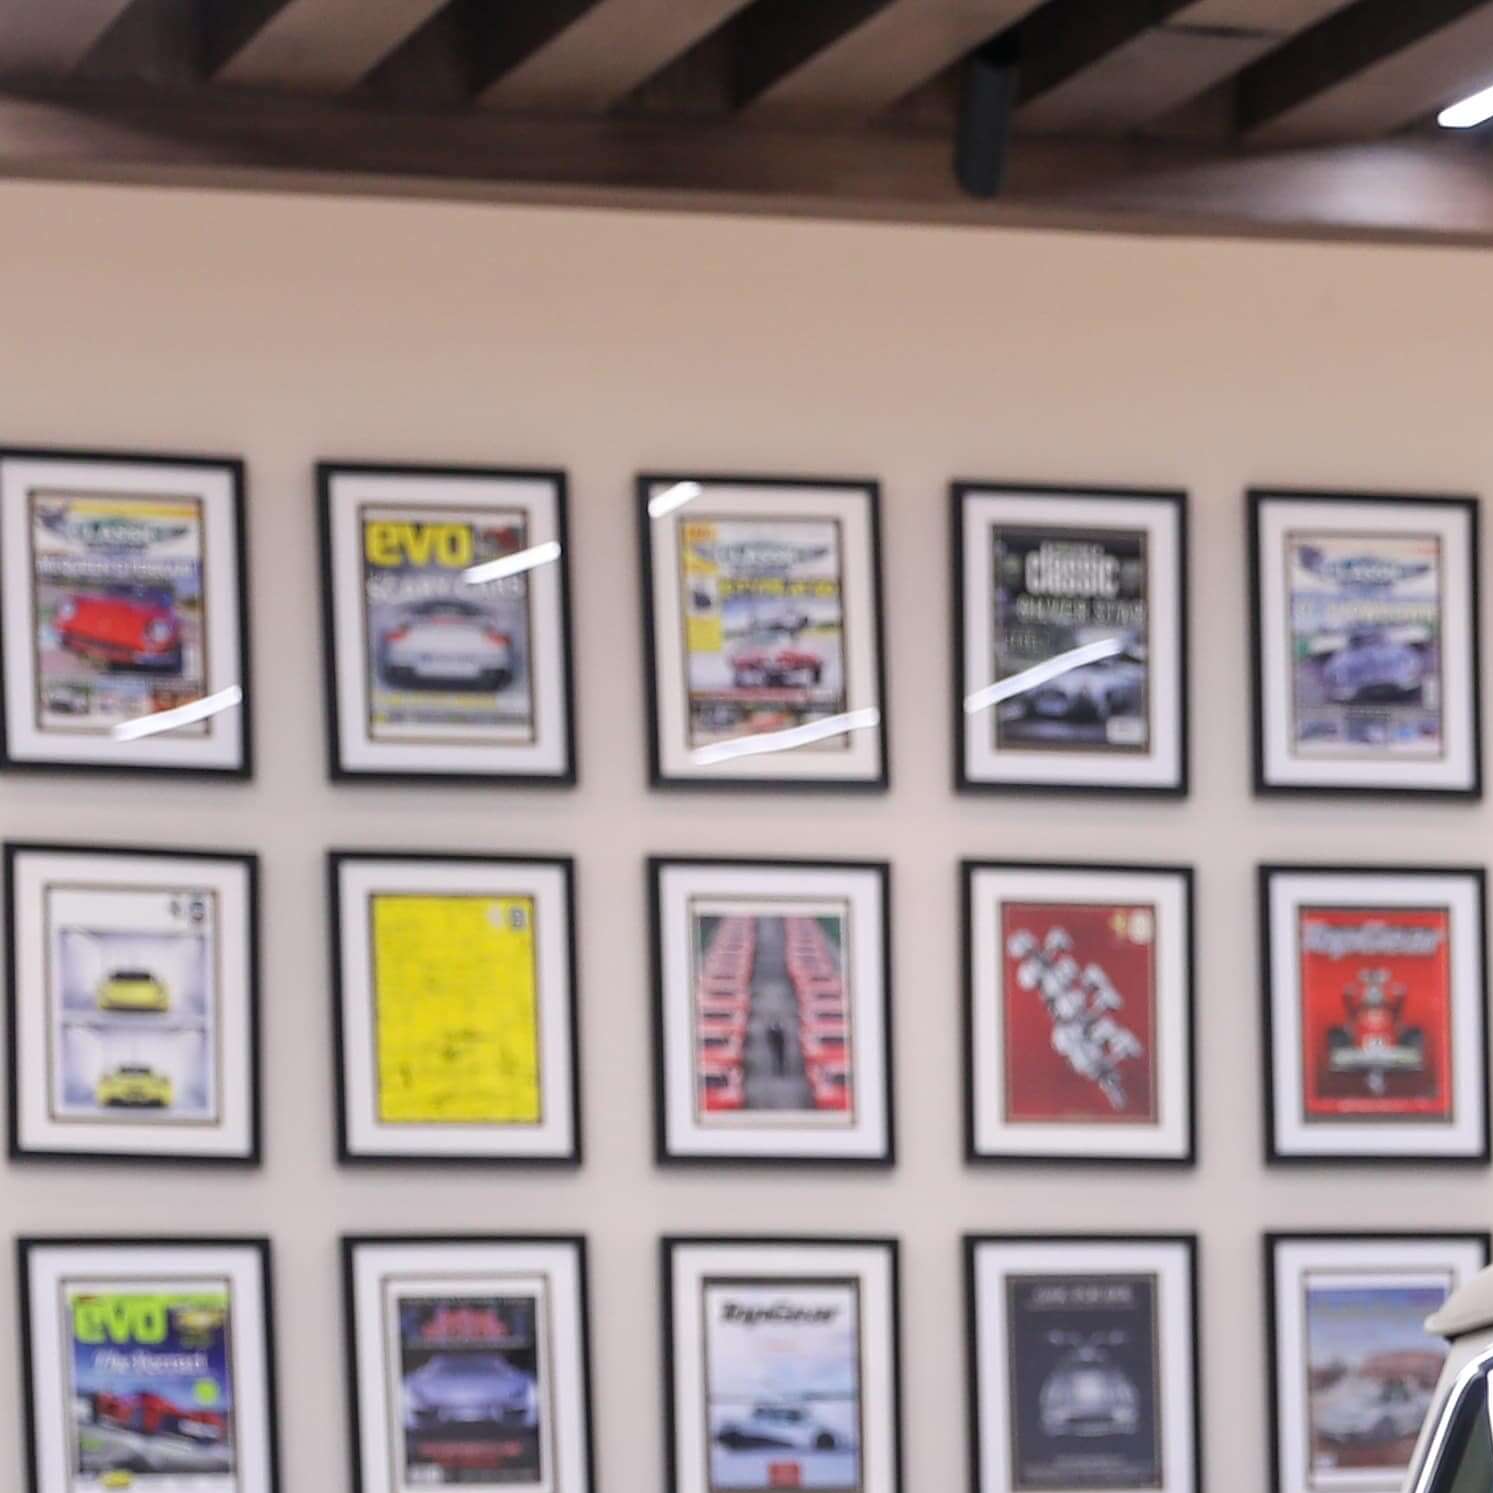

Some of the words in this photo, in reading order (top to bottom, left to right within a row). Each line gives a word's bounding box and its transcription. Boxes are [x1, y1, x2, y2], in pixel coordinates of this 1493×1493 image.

[366, 520, 474, 568] evo
[74, 1297, 167, 1344] evo
[720, 1300, 844, 1331] TopGear
